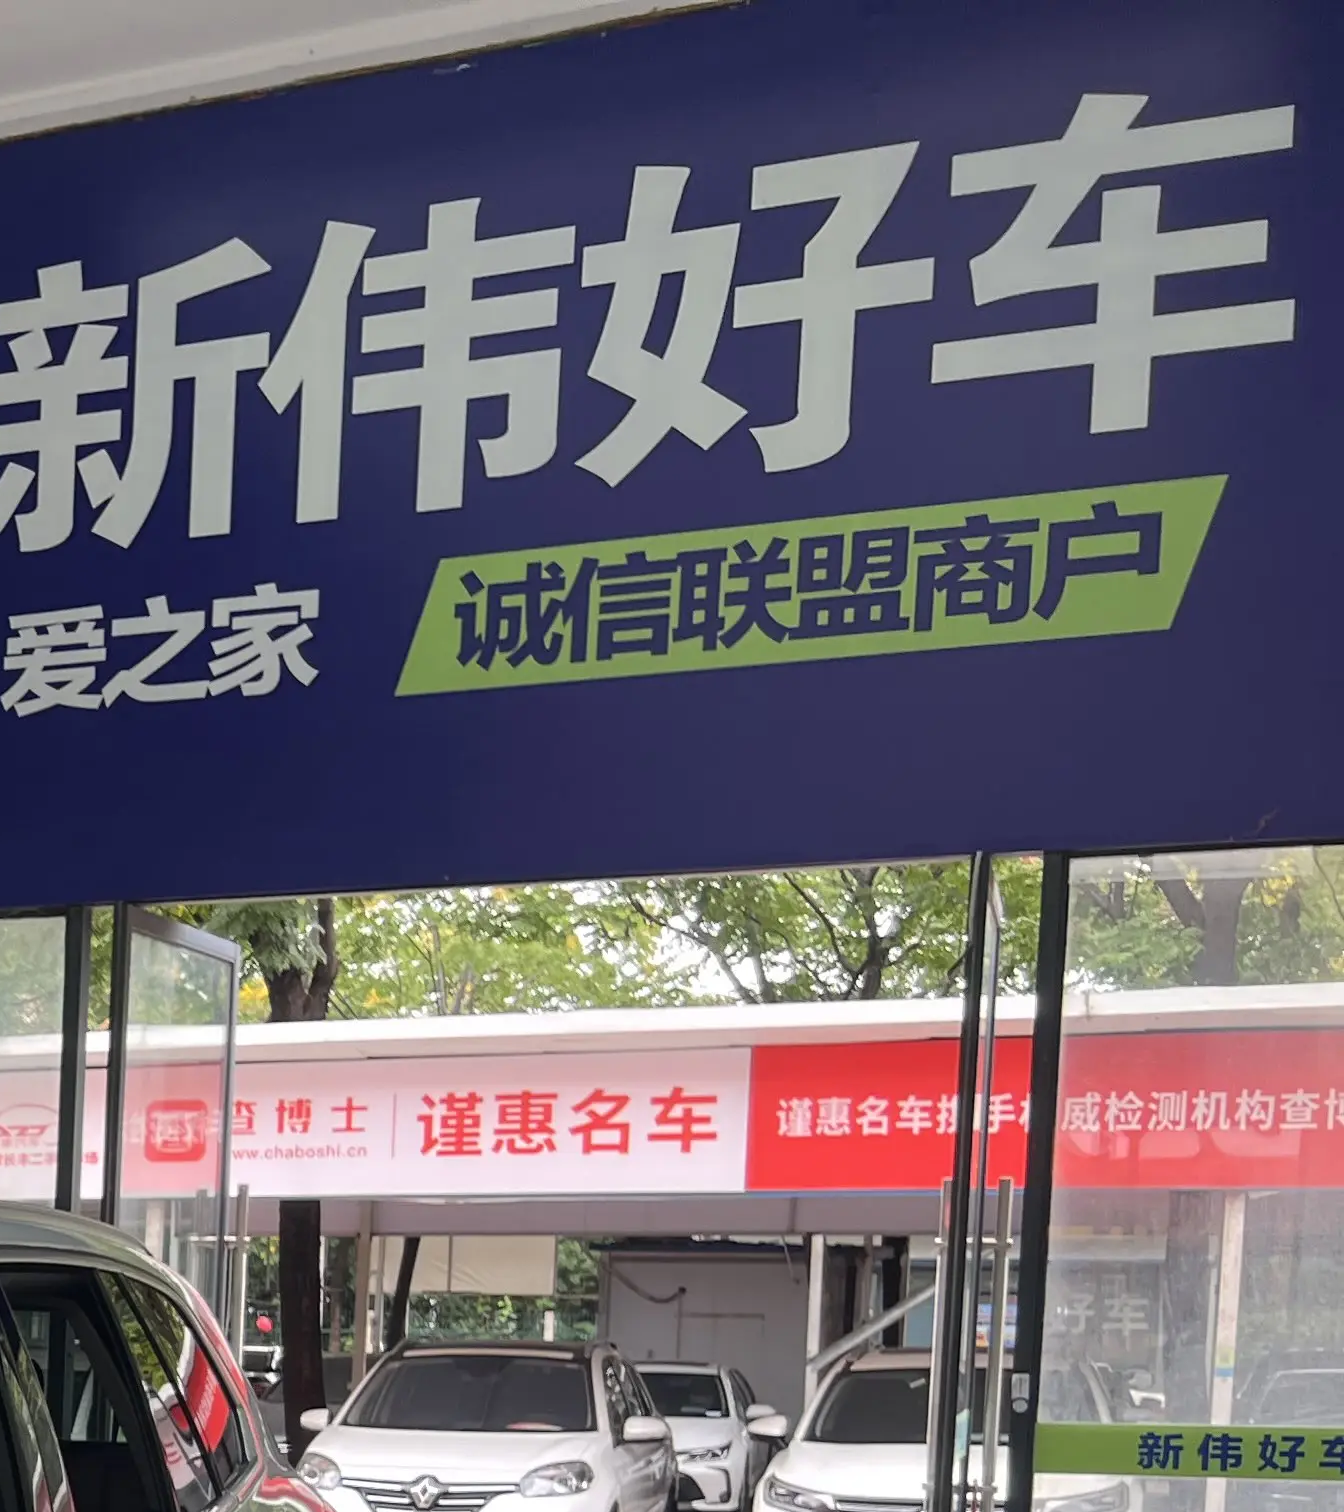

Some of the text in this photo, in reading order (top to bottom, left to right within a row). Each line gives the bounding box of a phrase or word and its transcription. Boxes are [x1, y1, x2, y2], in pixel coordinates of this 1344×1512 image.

[452, 499, 1164, 674] 诚信联盟商户
[232, 1144, 368, 1162] ww.chaboshi.cn
[416, 1085, 719, 1157] 谨惠名车
